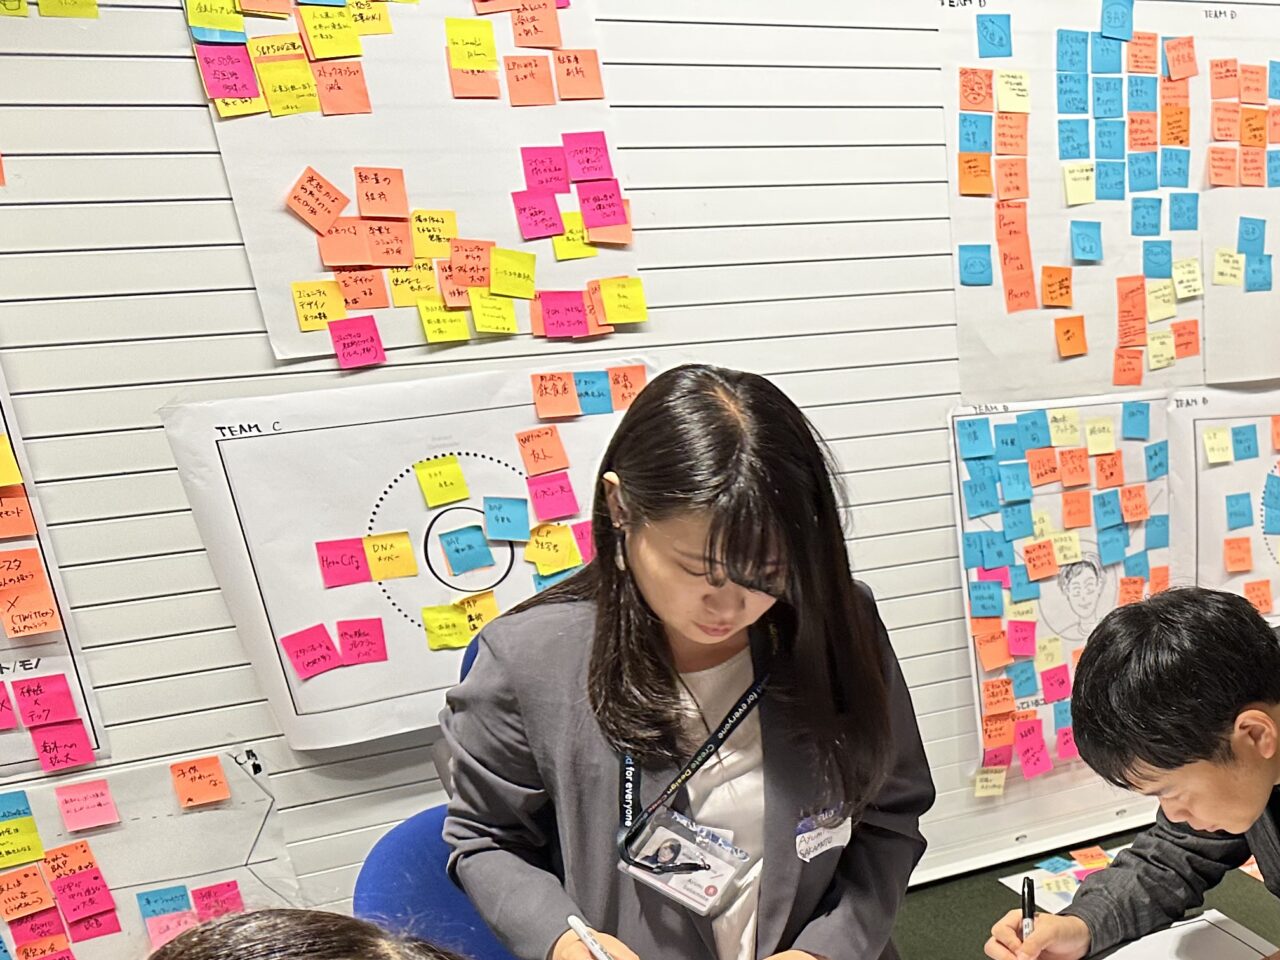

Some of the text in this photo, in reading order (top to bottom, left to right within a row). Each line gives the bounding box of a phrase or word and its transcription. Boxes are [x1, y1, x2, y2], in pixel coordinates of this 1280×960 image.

[1205, 9, 1228, 19] TEAM
[215, 421, 282, 438] TEAM C
[372, 544, 395, 552] DNX
[717, 703, 747, 739] everyone
[666, 744, 714, 794] Create Design
[623, 767, 635, 827] for everyone
